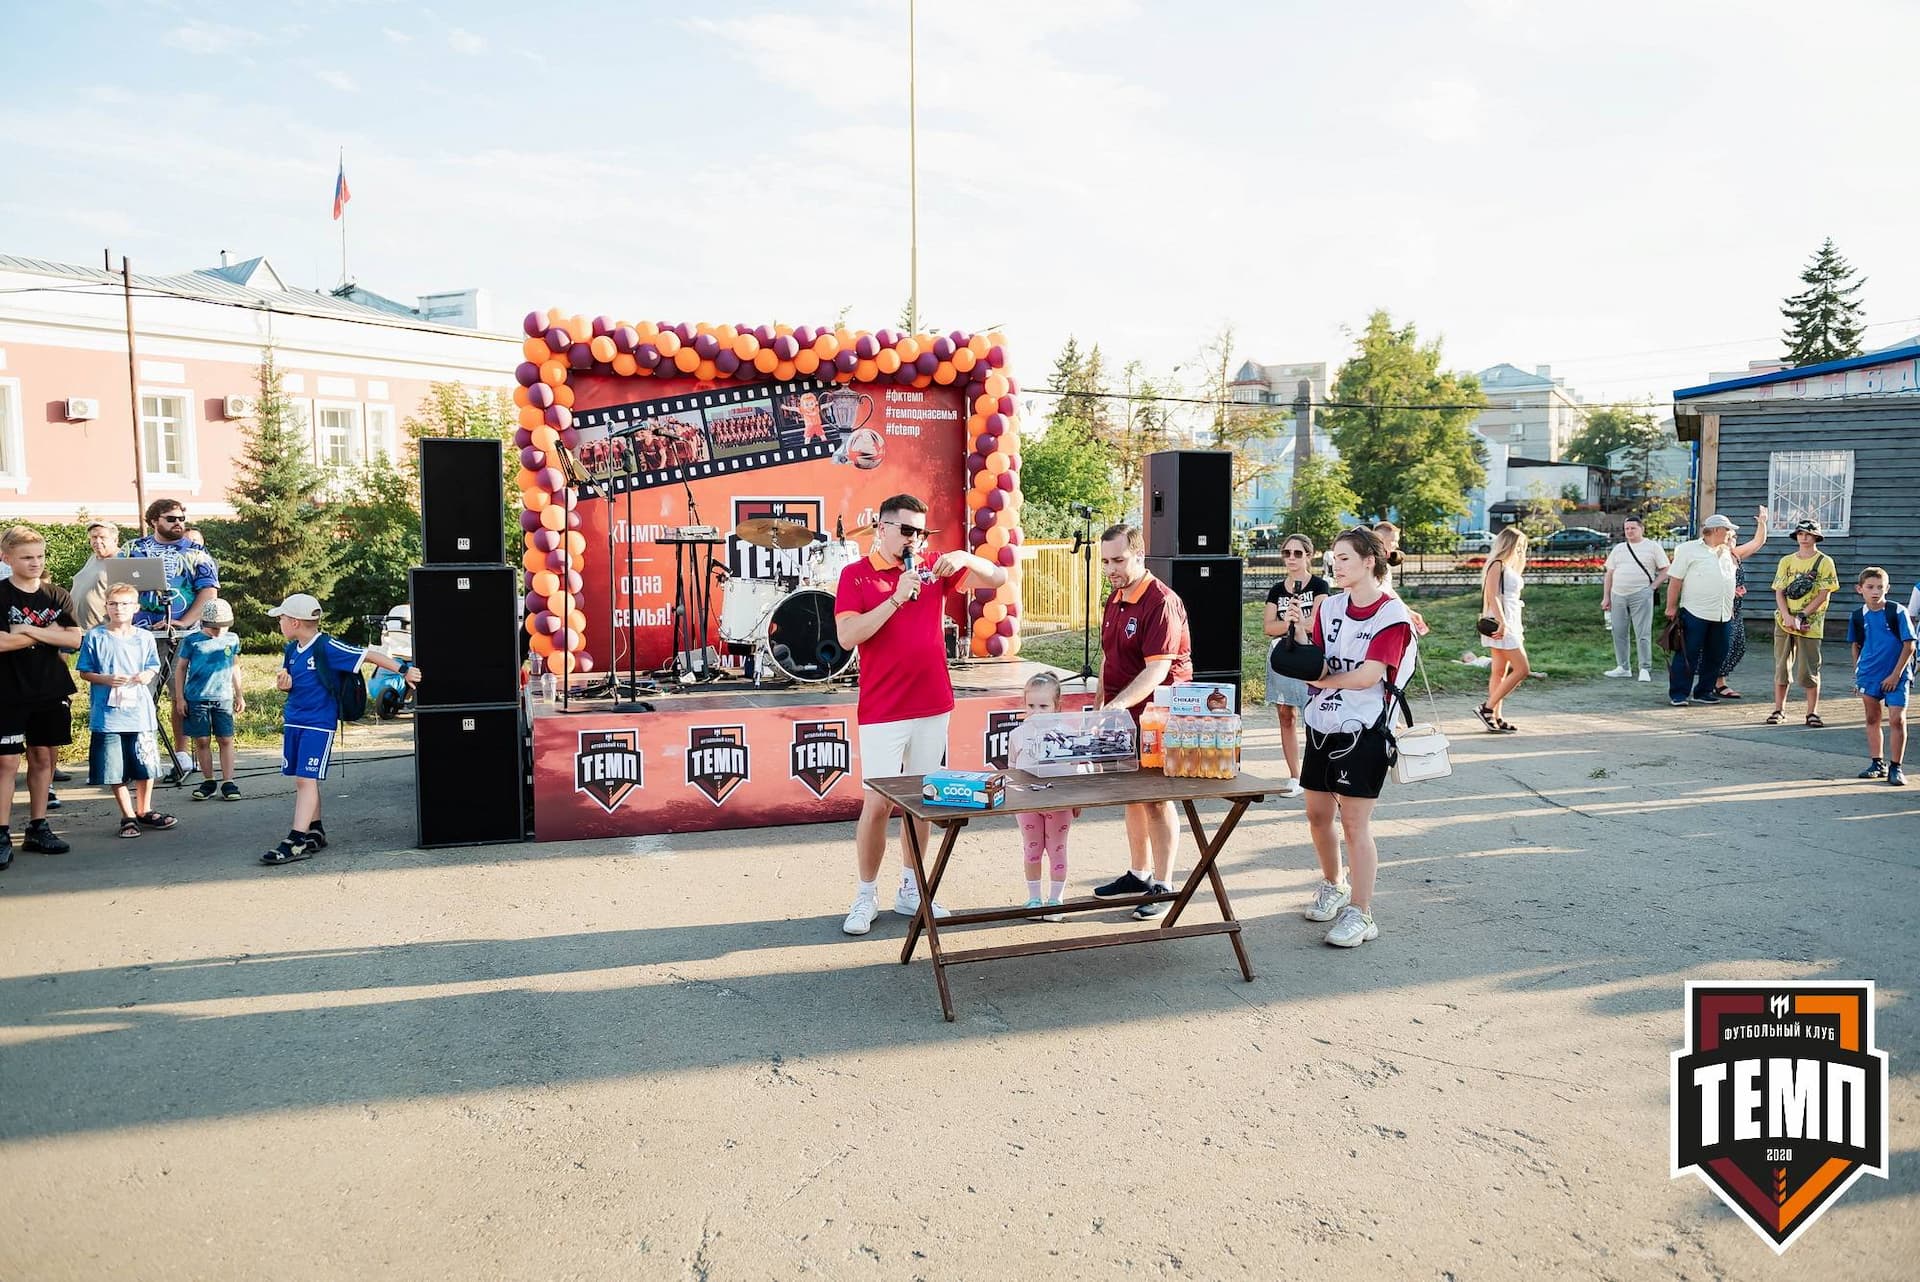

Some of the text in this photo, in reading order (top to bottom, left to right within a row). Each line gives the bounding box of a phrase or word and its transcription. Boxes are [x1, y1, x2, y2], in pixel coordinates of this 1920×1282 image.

[886, 389, 924, 403] #фктемп
[886, 406, 957, 420] #темподнасемья
[886, 423, 920, 437] #fctemp
[620, 576, 662, 596] одна
[613, 603, 671, 627] семья!
[308, 758, 319, 766] 20
[691, 748, 744, 776] ТЕМП
[795, 742, 846, 770] ТЕМП
[582, 753, 637, 782] ТЕМП
[943, 786, 972, 796] COCO
